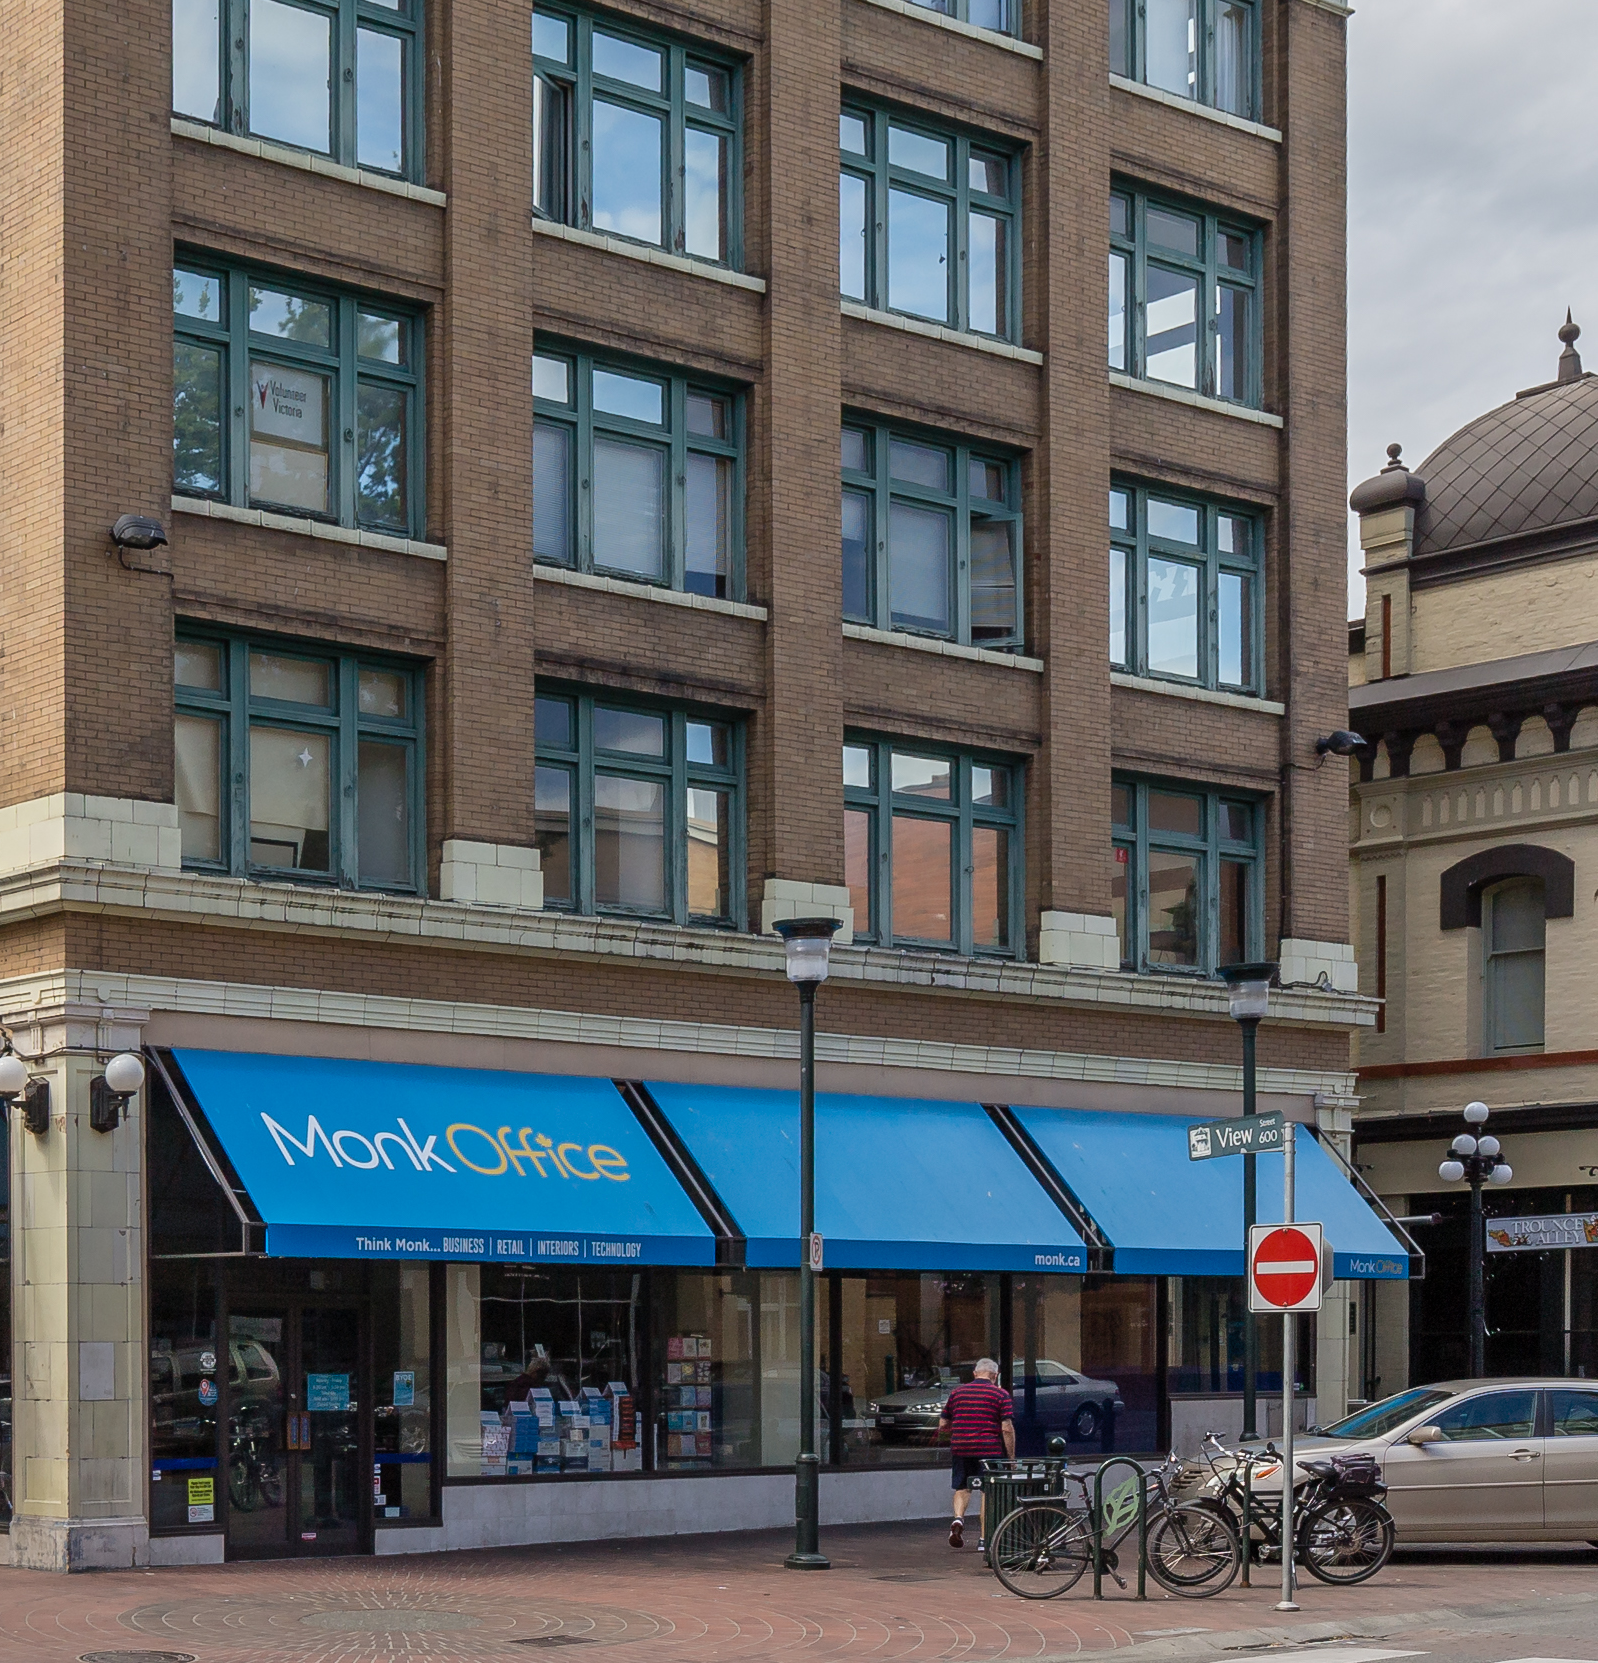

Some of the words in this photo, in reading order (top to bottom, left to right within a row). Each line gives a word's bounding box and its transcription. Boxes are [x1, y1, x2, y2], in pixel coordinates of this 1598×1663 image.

[269, 380, 307, 403] Volunteer
[272, 398, 303, 419] Victoria
[1215, 1127, 1253, 1149] View
[1258, 1129, 1278, 1144] 600
[1511, 1218, 1584, 1234] TROUNCE
[356, 1236, 393, 1252] Think
[395, 1238, 441, 1253] Monk...
[443, 1237, 485, 1255] BUSINESS
[497, 1241, 525, 1256] RETAIL
[537, 1240, 579, 1257] INTERIORS
[591, 1241, 642, 1258] TECHNOLOGY
[1536, 1230, 1583, 1246] ALLEY
[1034, 1252, 1081, 1268] monk.ca
